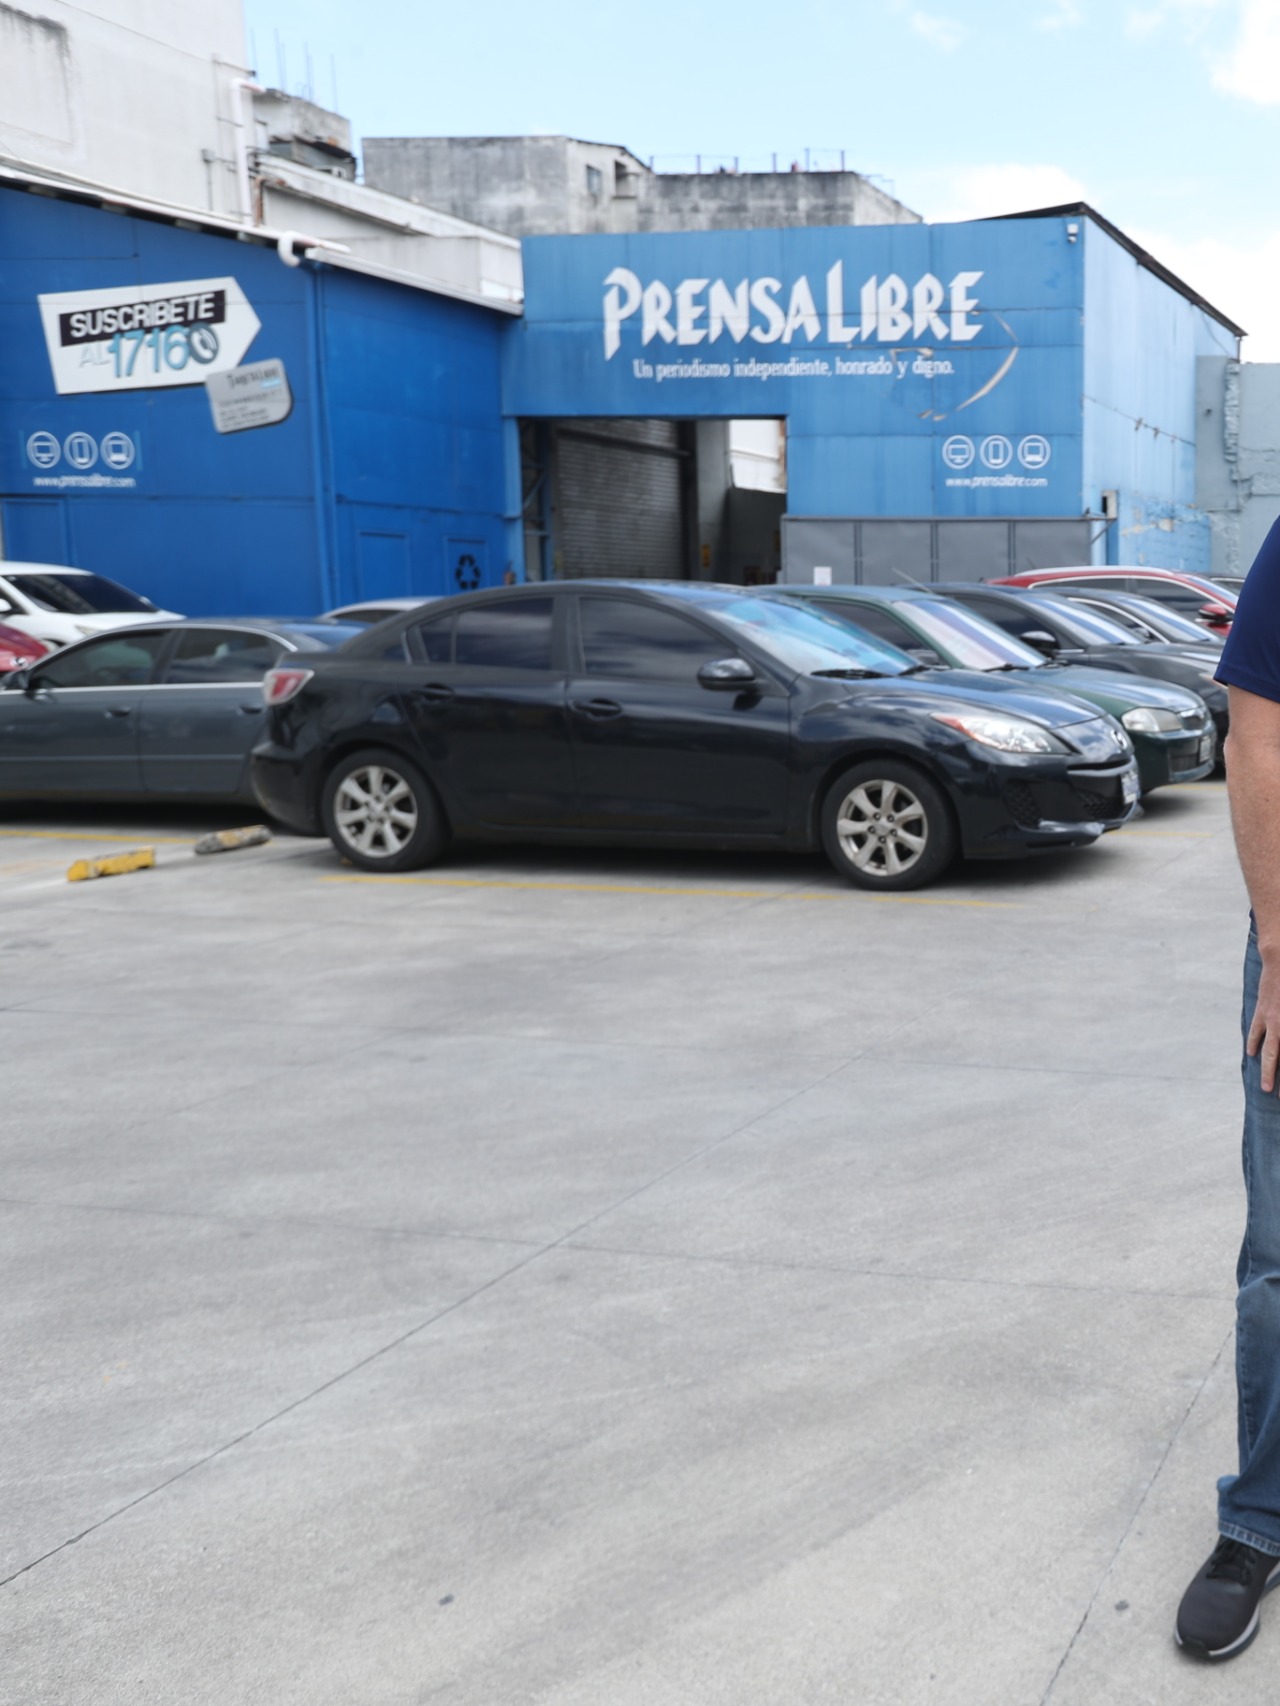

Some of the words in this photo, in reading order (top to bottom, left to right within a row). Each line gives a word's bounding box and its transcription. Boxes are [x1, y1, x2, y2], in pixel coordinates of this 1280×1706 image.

[70, 292, 215, 338] SUSCRIBETE
[632, 358, 653, 378] Un
[655, 358, 730, 383] periodismo
[733, 357, 832, 381] independiente,
[835, 355, 893, 375] honrado
[896, 360, 907, 379] y
[912, 355, 955, 379] digno.
